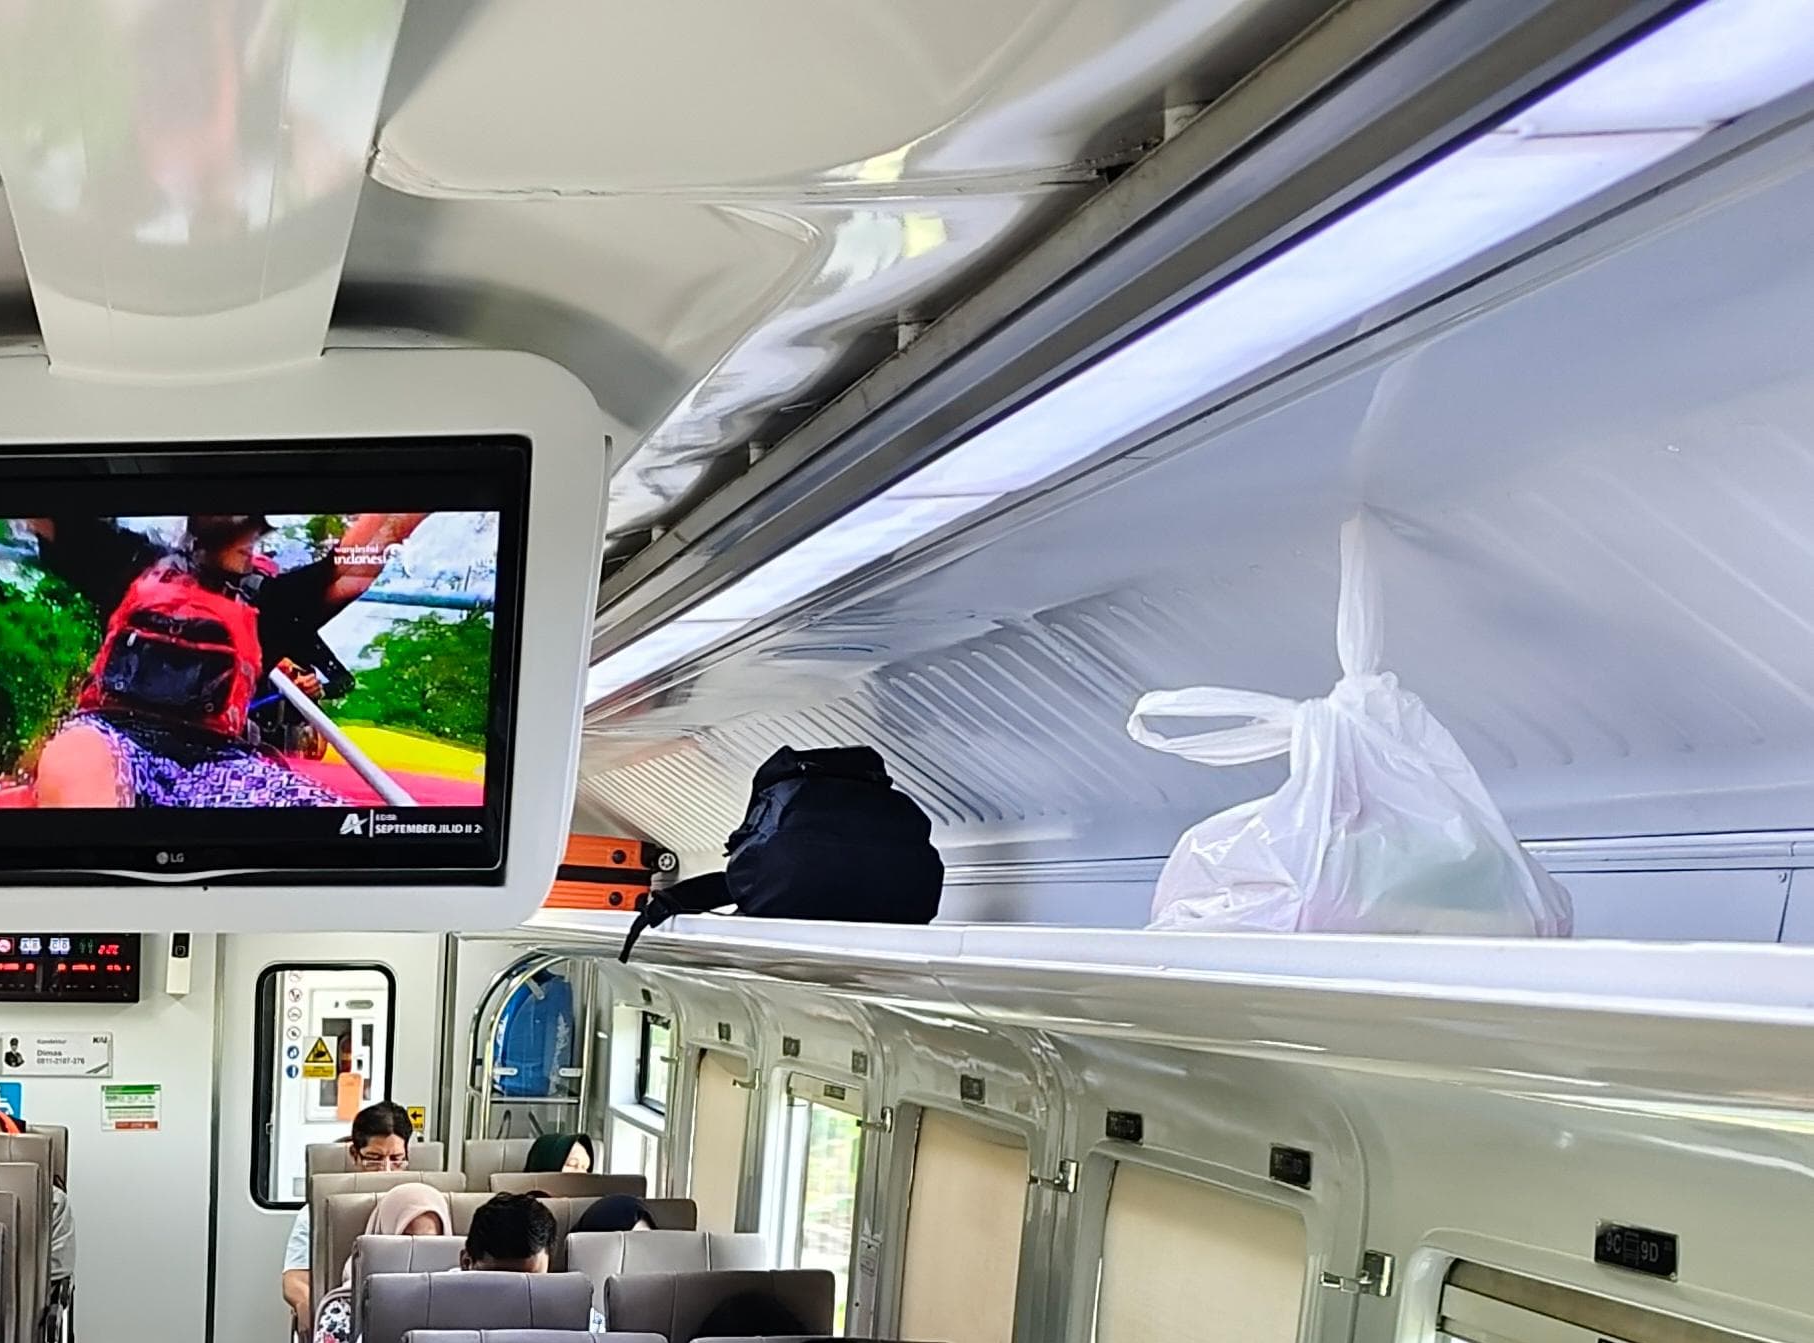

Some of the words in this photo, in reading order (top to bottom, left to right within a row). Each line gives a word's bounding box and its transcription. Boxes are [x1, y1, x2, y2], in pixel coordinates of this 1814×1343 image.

[375, 824, 436, 834] SEPTEMBER
[170, 852, 185, 863] LG
[1606, 1233, 1623, 1254] 9C
[1640, 1240, 1659, 1262] 9D
